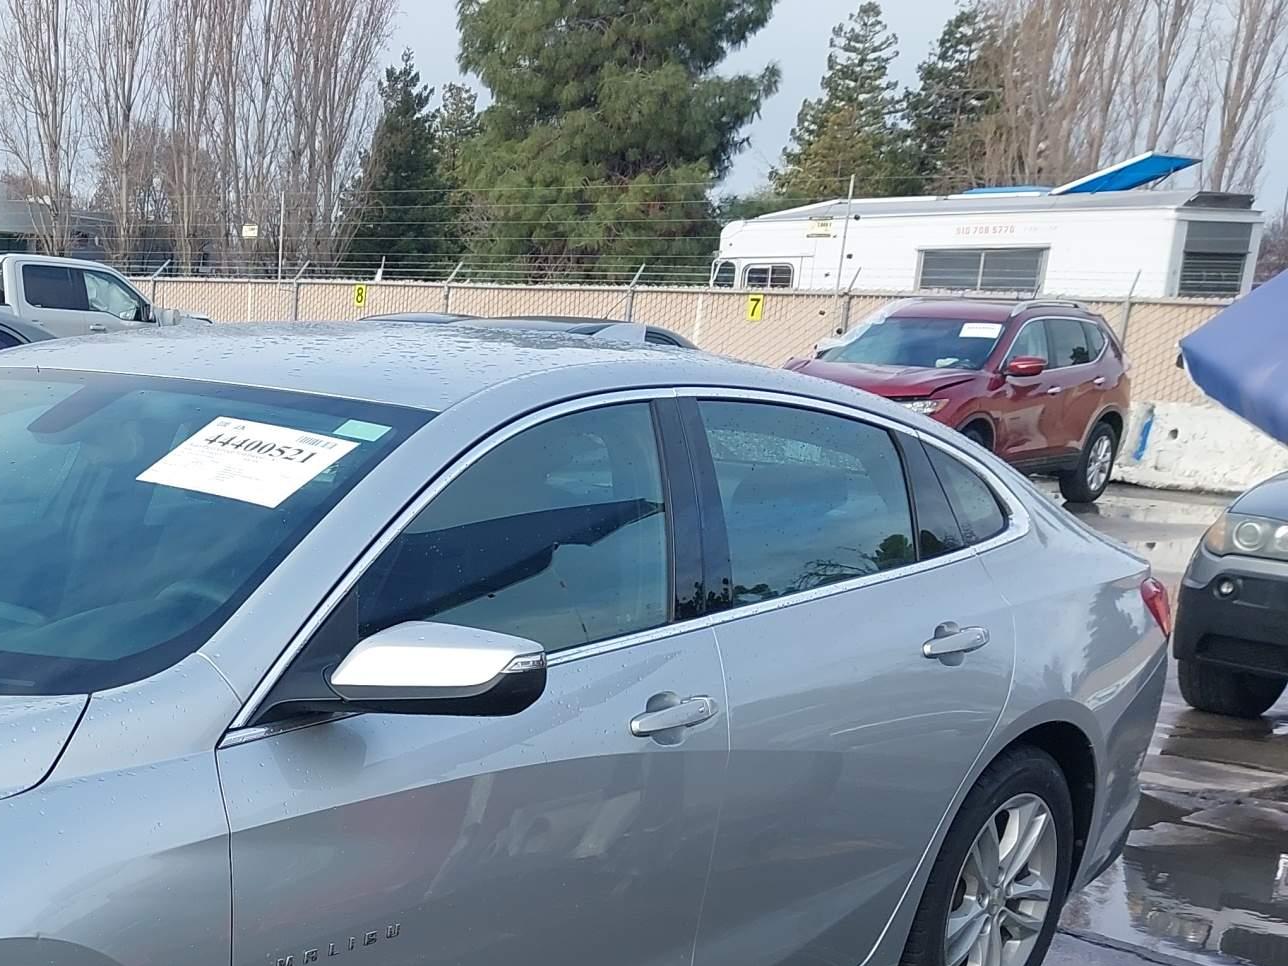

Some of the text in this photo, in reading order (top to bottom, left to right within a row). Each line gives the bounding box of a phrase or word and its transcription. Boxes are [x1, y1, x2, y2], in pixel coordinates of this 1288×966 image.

[356, 287, 364, 303] 8
[750, 297, 761, 317] 7
[205, 433, 317, 463] 44400521
